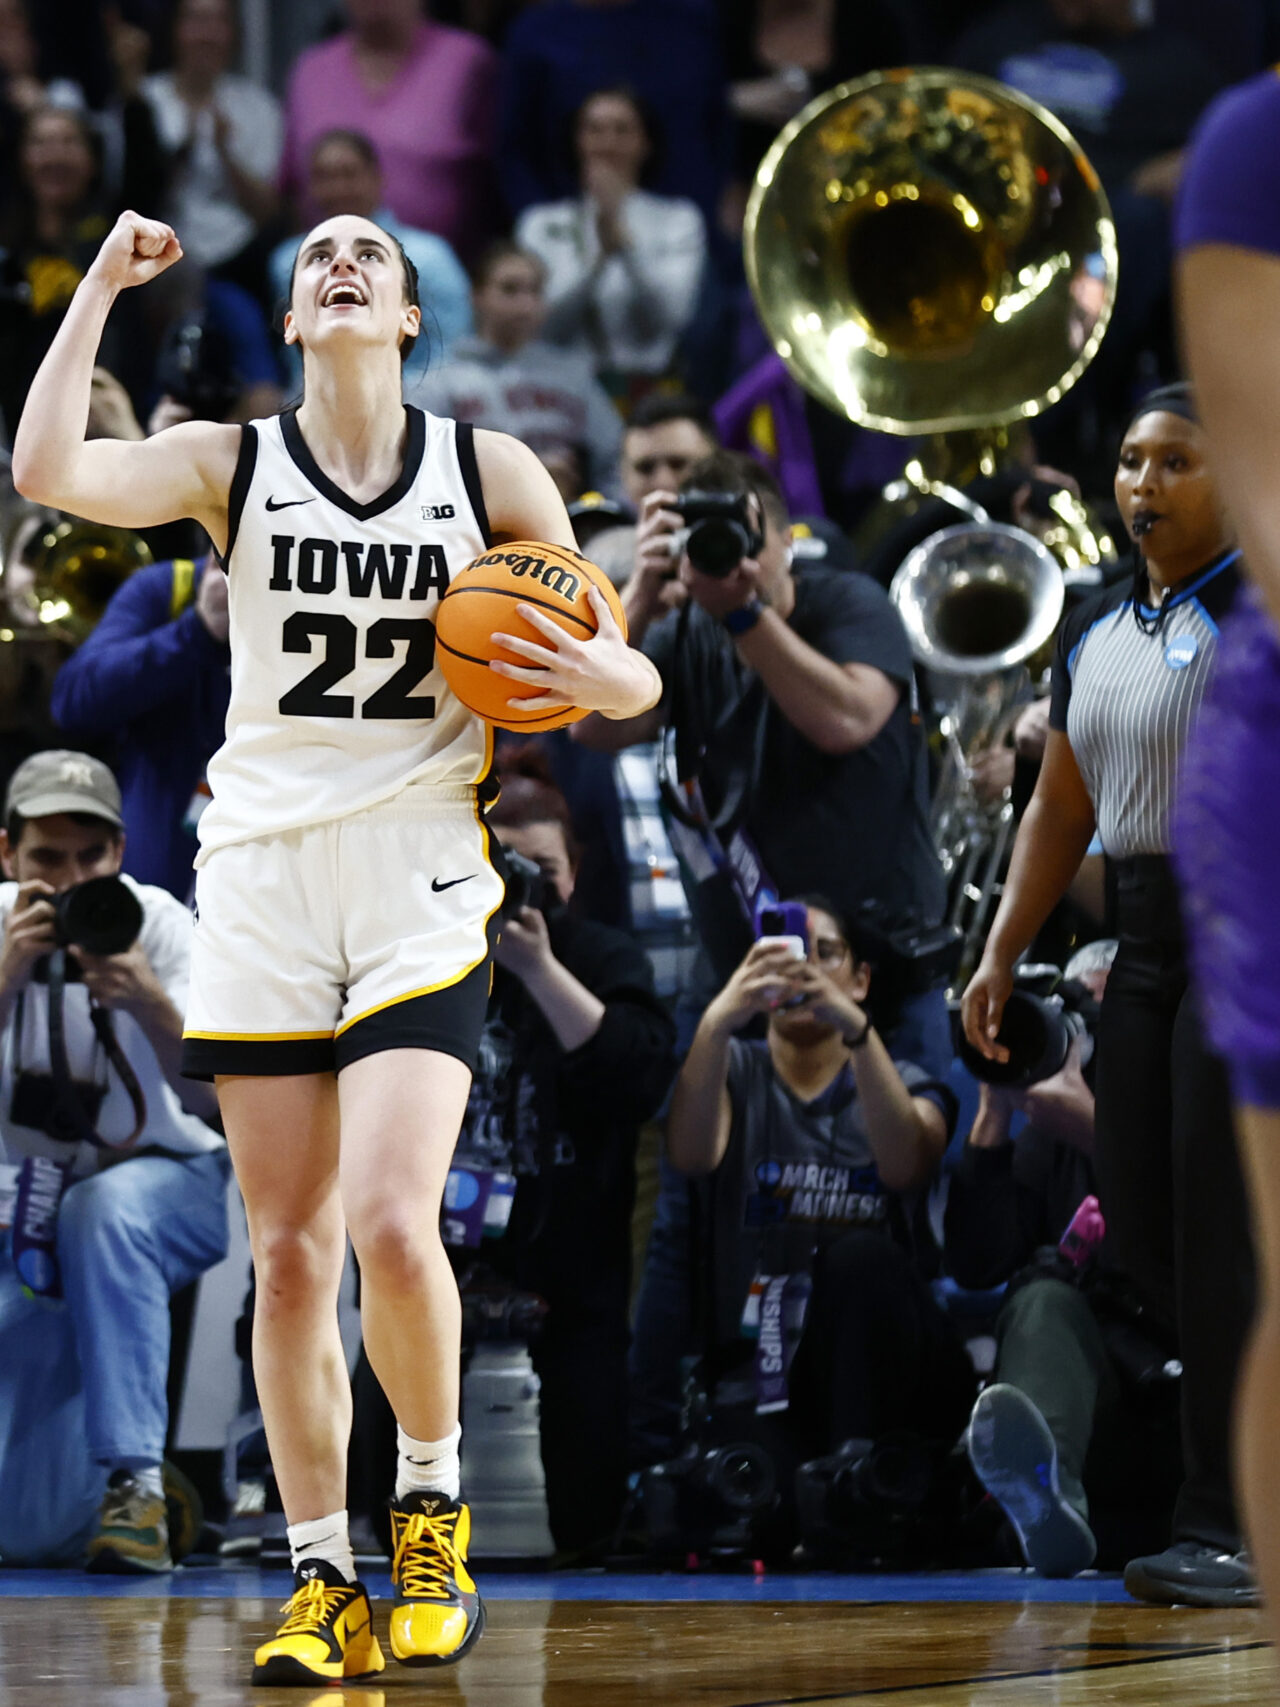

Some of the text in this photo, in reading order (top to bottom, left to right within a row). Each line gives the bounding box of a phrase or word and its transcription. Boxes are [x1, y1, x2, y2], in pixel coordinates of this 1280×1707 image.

[269, 534, 450, 601] IOWA
[467, 552, 582, 604] Wilson
[279, 611, 437, 720] 22
